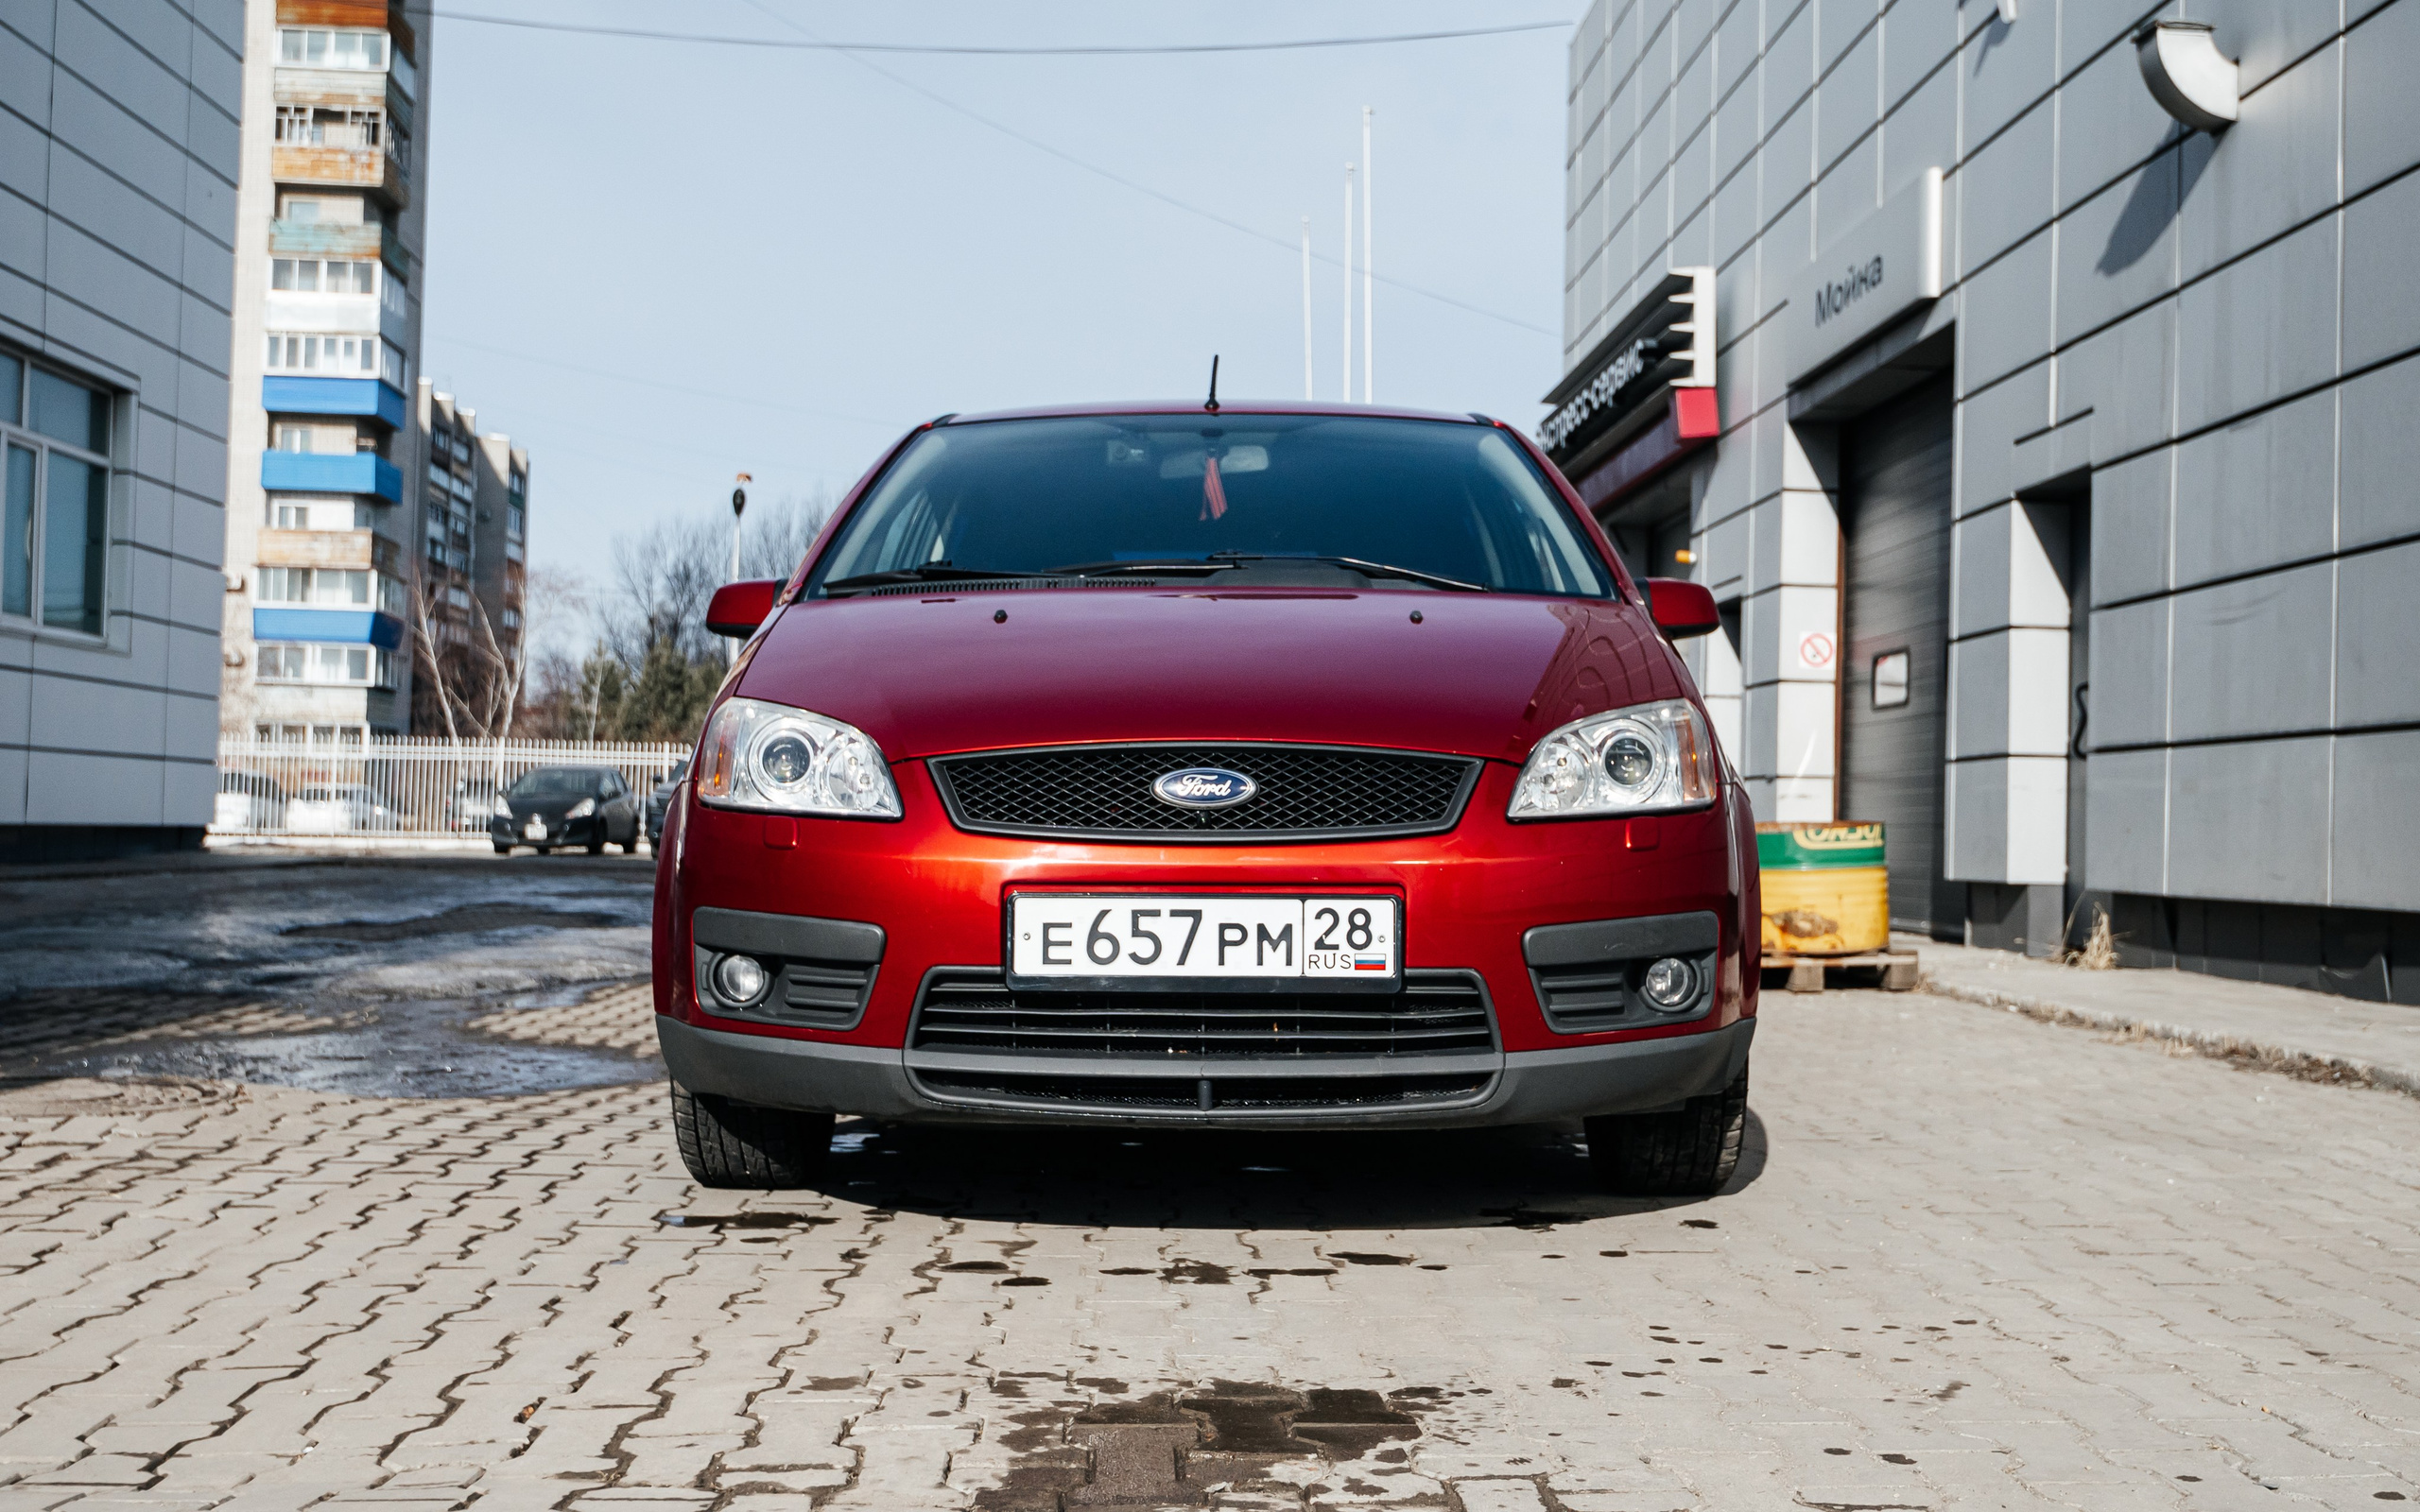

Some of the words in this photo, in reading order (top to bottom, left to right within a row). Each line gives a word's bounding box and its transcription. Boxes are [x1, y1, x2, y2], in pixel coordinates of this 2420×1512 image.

[1176, 774, 1232, 796] Ford
[1314, 907, 1372, 951] 28
[1308, 953, 1352, 970] RUS
